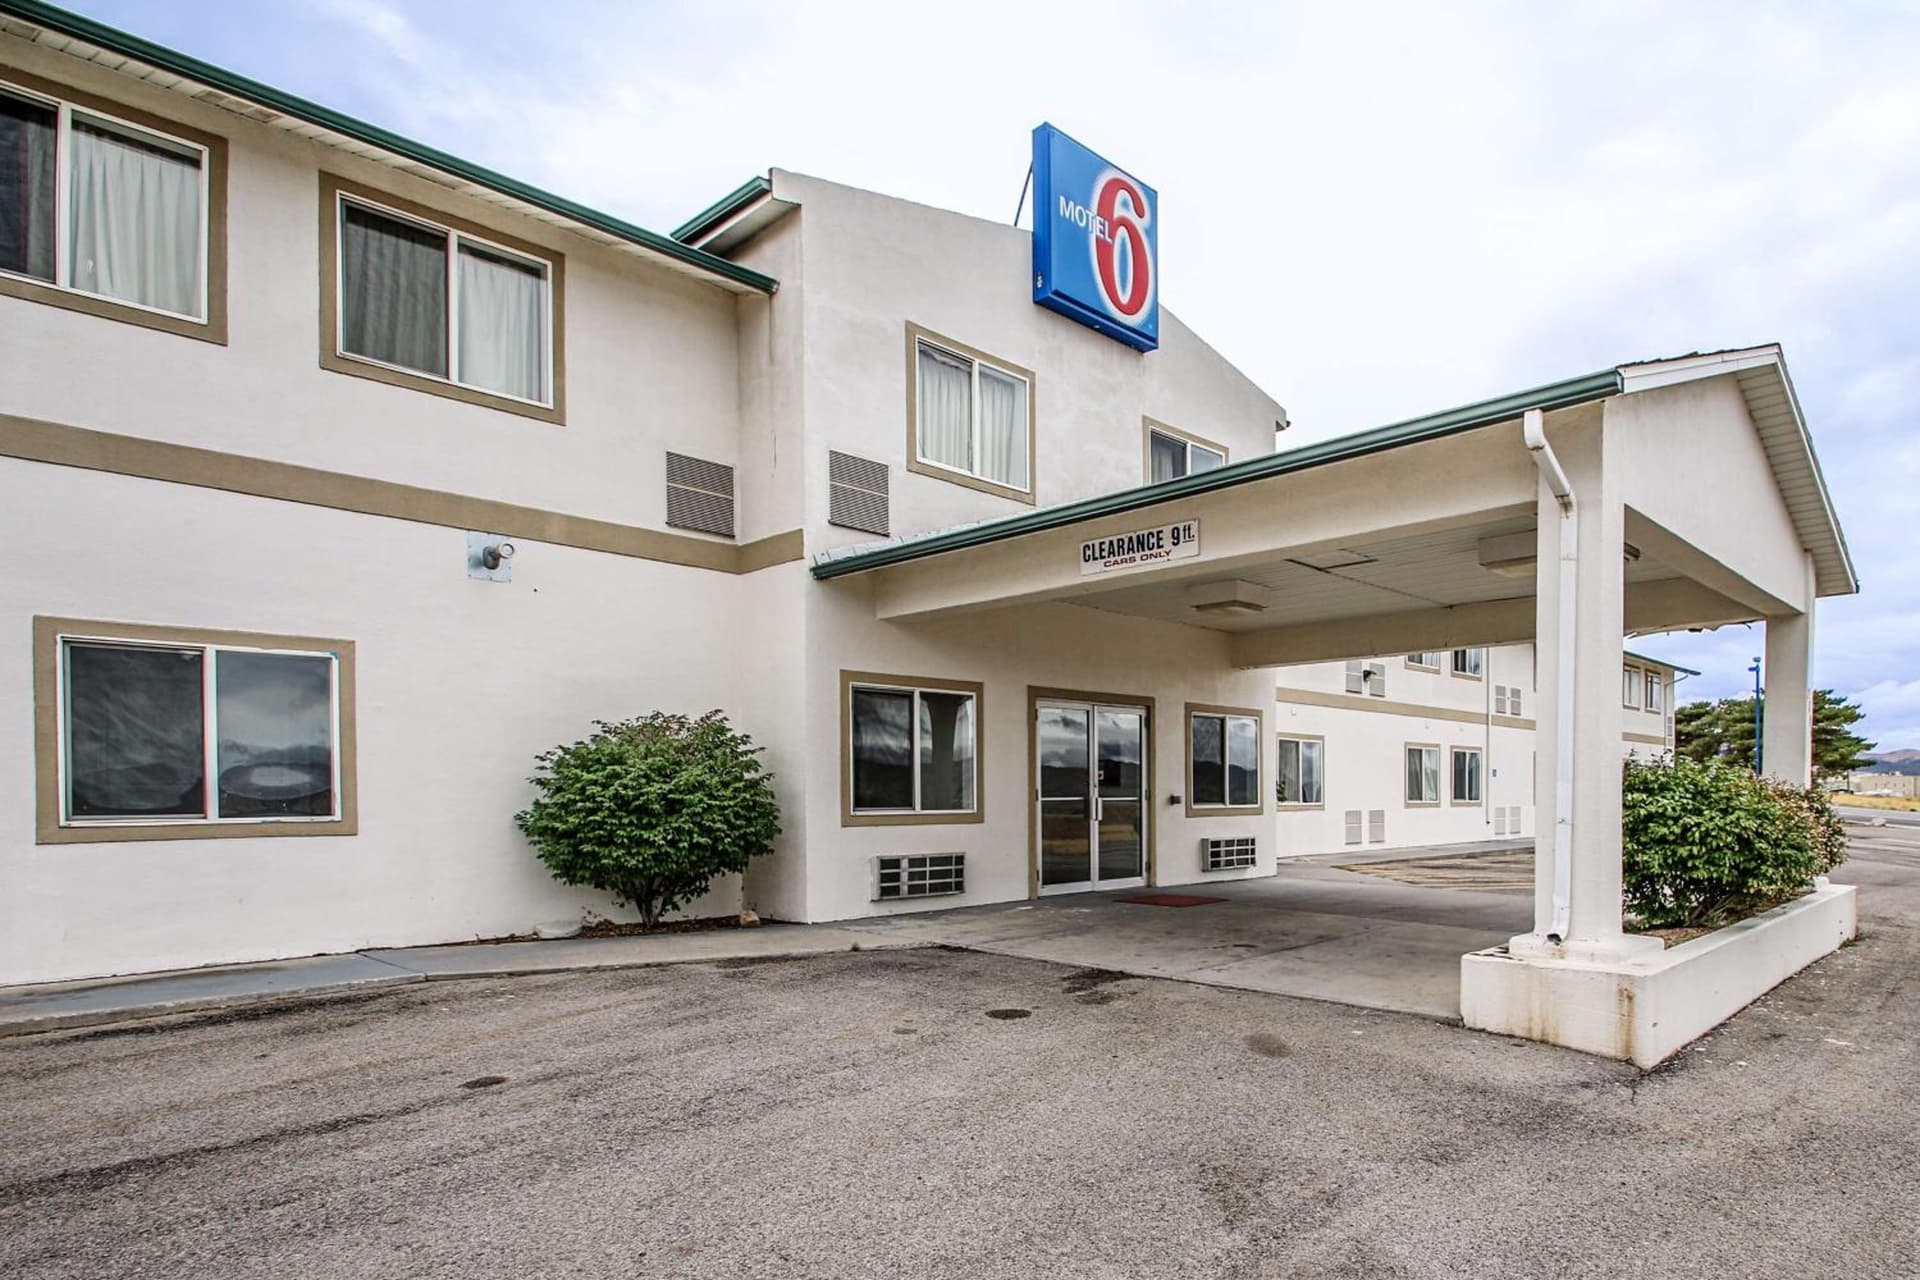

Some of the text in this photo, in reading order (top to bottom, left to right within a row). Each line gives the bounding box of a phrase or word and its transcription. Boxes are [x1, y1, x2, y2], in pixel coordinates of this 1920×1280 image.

[1059, 176, 1150, 317] MOTEL 6
[1082, 529, 1164, 563] CLEARANCE
[1103, 549, 1172, 568] CARS ONLY
